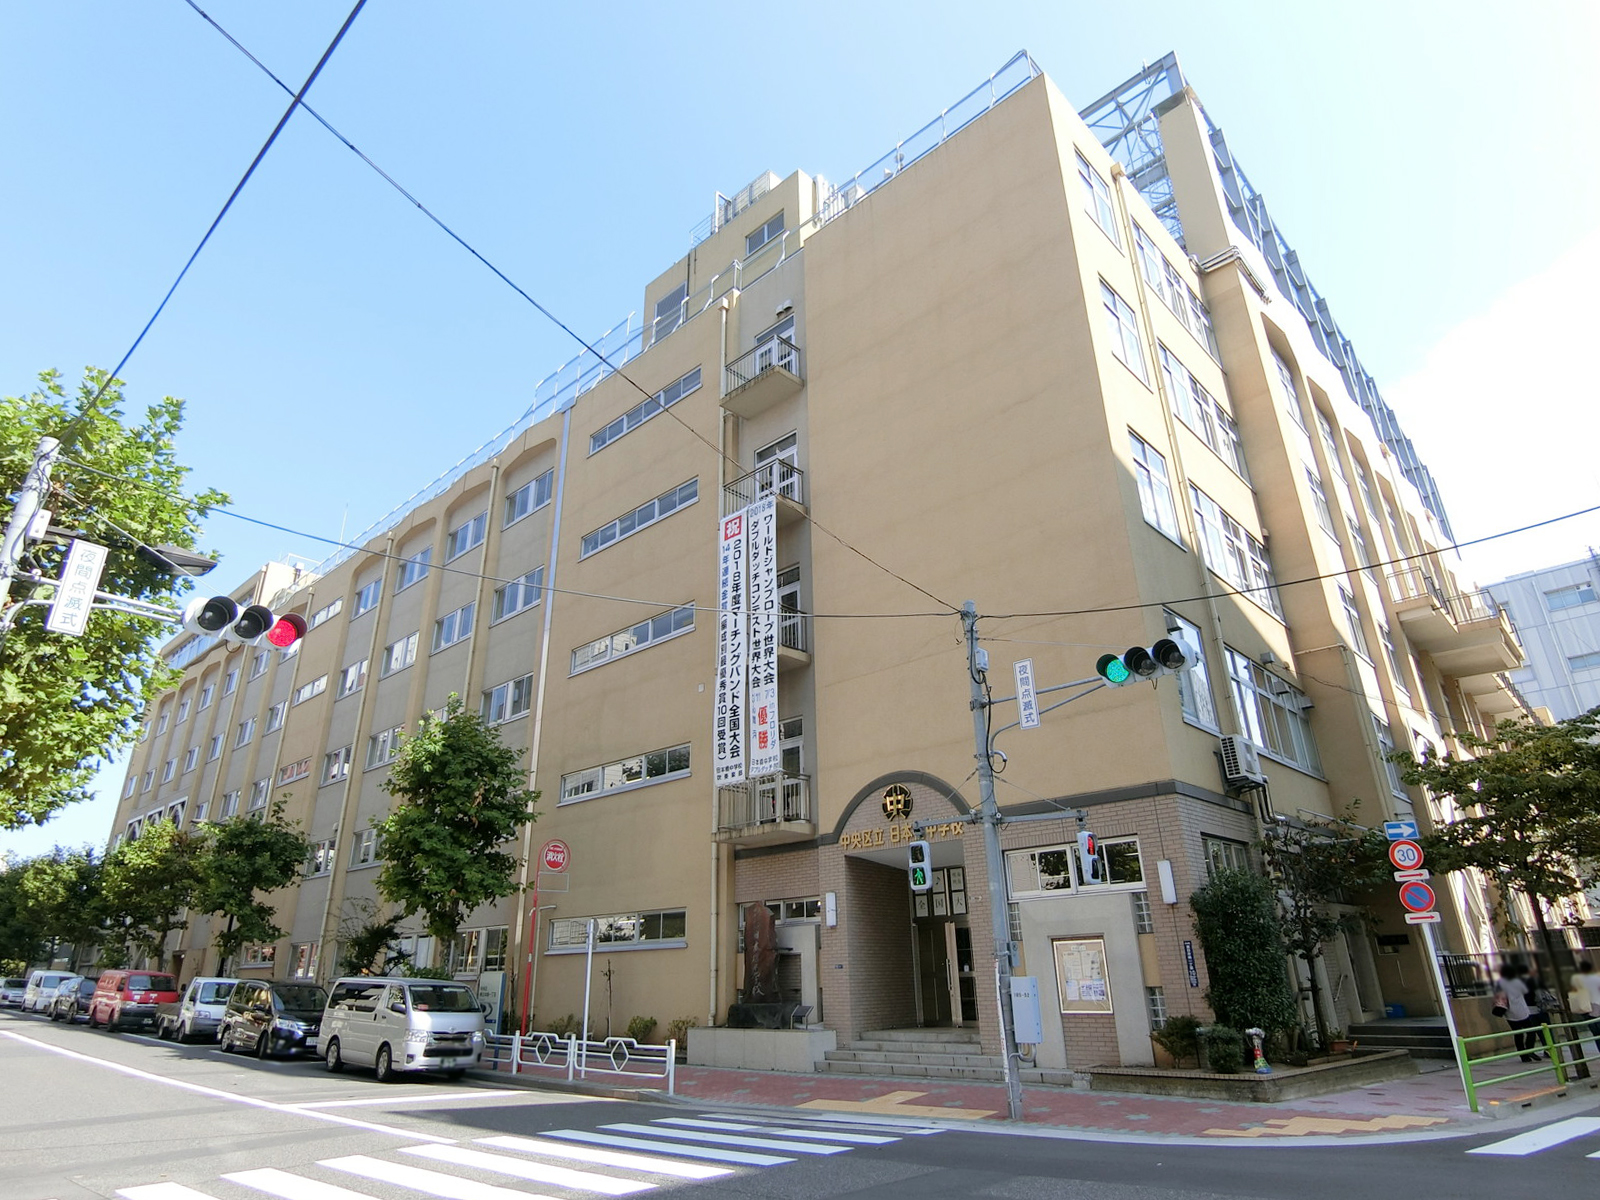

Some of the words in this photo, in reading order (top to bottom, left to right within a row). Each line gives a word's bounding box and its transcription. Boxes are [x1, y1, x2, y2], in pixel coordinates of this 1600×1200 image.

[726, 520, 740, 538] 祝
[750, 500, 774, 518] 2018年
[59, 549, 98, 628] 夜間点滅式
[751, 520, 761, 689] ダブルダッチコンテスト世界大会
[763, 513, 775, 686] ワールドジャンプロープ世界大会
[729, 538, 742, 759] 2018年度マーチングバンド全国大会
[1018, 664, 1035, 724] 夜間点滅式
[840, 827, 885, 851] 中央区立
[1397, 848, 1416, 863] 30
